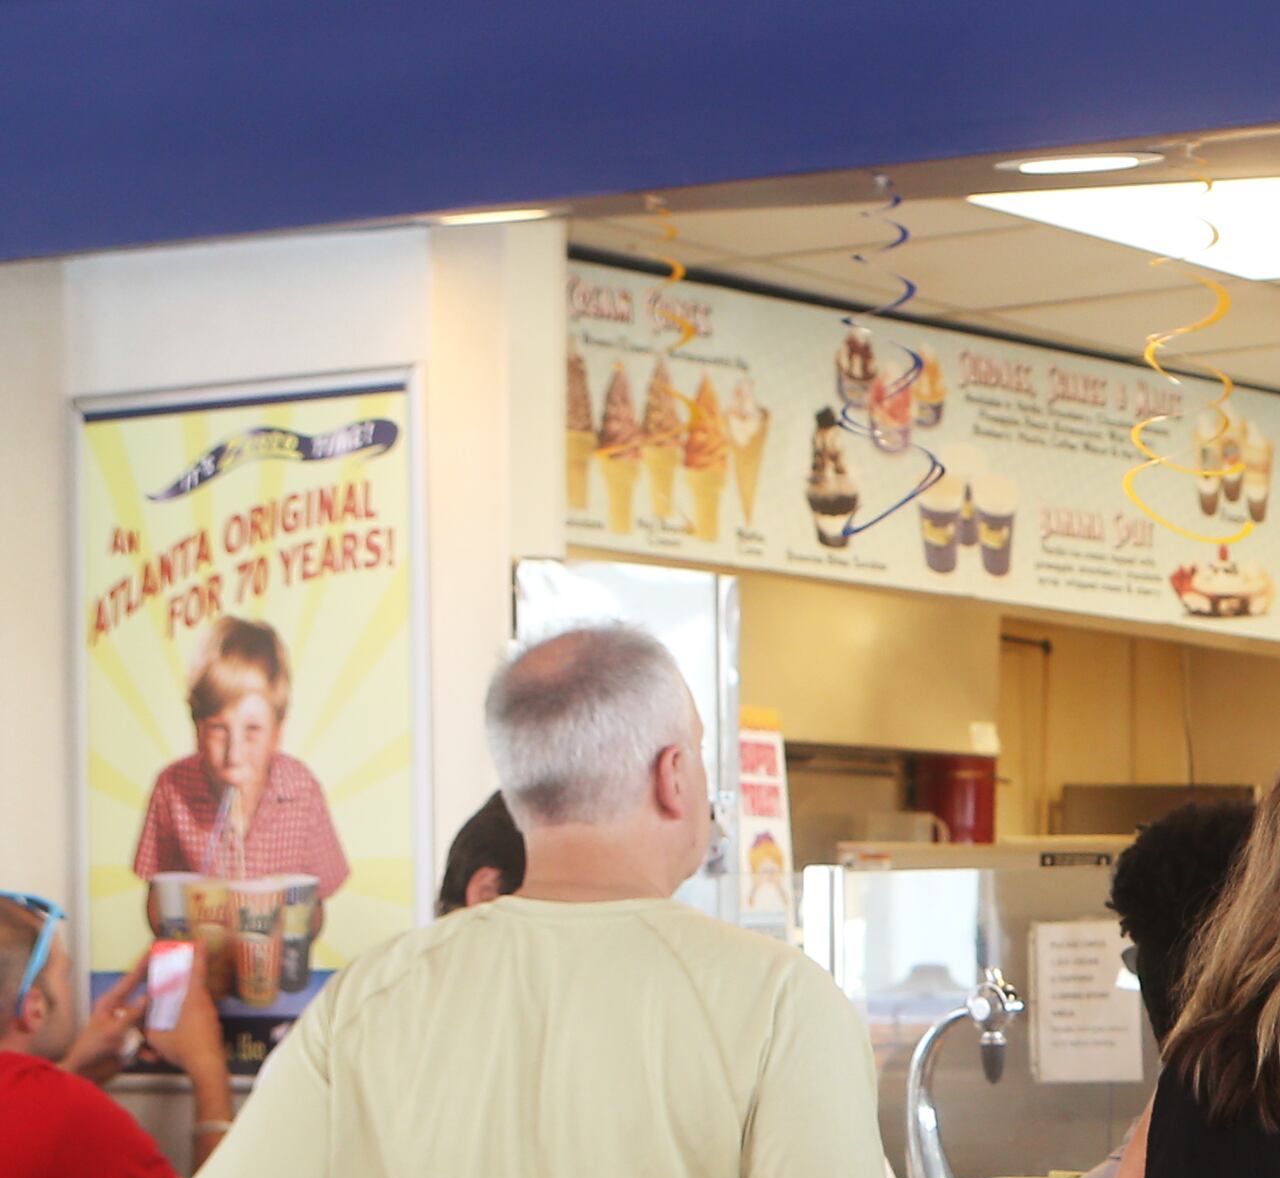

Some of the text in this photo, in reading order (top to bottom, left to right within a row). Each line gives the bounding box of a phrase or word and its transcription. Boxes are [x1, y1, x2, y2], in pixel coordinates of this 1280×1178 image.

[91, 478, 380, 647] ATLANTA ORIGINAL
[163, 527, 398, 641] FOR 70 YEARS!
